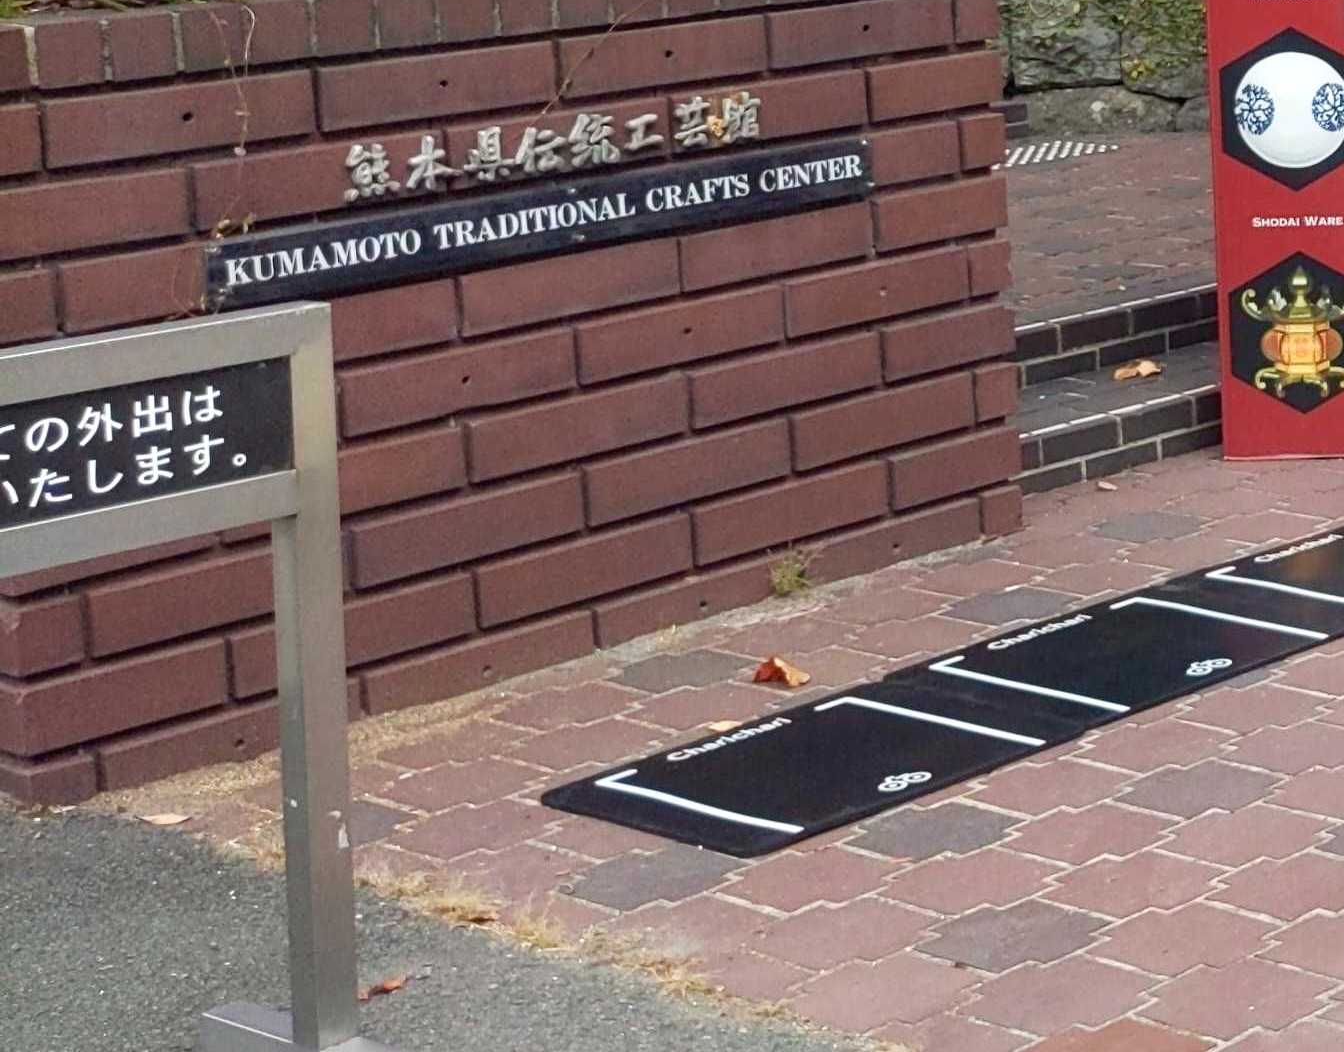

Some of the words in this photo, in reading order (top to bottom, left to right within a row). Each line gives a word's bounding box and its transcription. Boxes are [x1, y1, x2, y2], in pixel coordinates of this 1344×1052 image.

[344, 91, 762, 203] 熊本県伝統工芸館
[226, 229, 422, 287] KUMAMOTO
[433, 193, 636, 246] TRADITIONAL
[645, 173, 749, 212] CRAFTS
[759, 154, 863, 193] CENTER
[987, 613, 1093, 651] Charichari
[666, 716, 793, 763] Charichari
